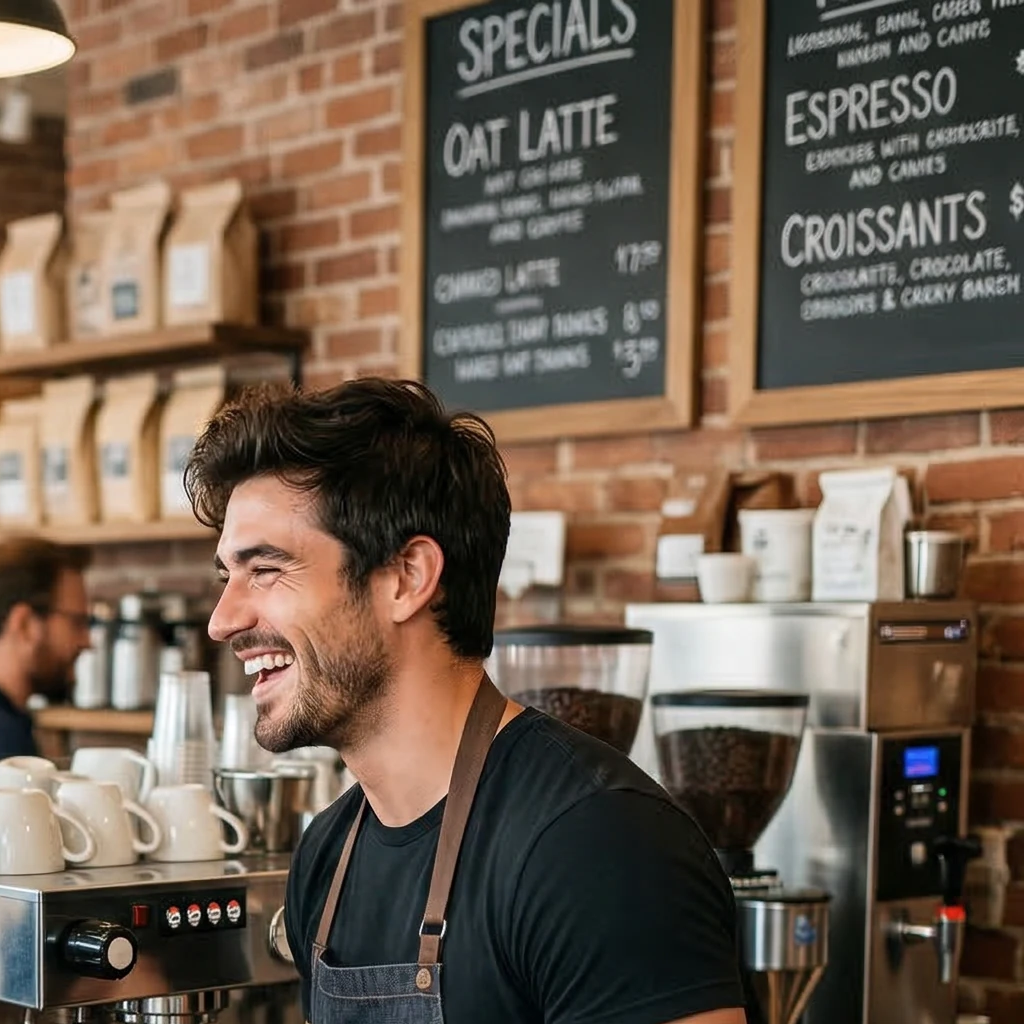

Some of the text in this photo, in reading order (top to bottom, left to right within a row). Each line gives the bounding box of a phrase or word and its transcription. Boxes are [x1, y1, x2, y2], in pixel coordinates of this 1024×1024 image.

[457, 0, 637, 82] SPECIALS
[443, 118, 510, 177] OAT
[519, 93, 618, 161] LATTE
[786, 66, 957, 146] ESPRESSO
[781, 190, 987, 267] CROISSANTS
